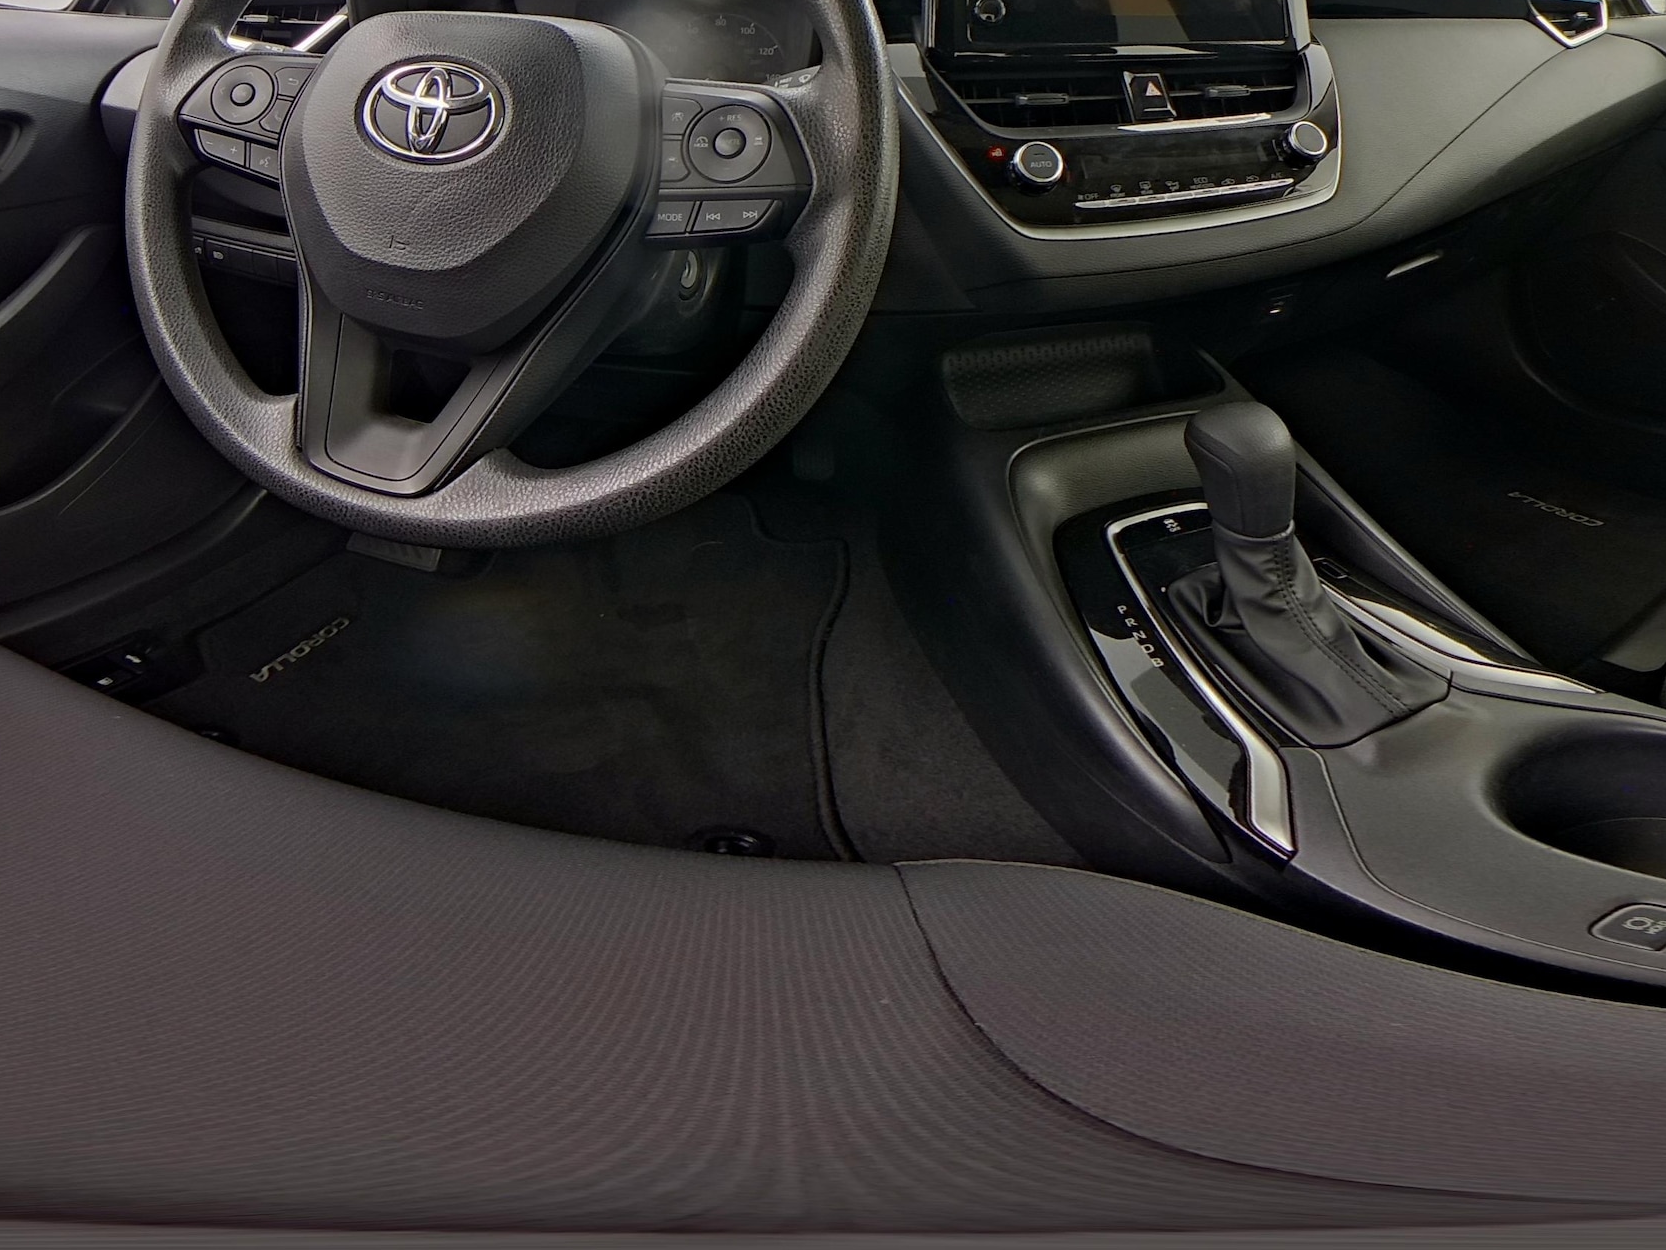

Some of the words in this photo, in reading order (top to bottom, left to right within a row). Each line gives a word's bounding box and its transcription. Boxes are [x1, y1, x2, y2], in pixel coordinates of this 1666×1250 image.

[741, 27, 755, 35] 100
[759, 48, 774, 56] 120
[1030, 160, 1053, 168] AUTO
[1193, 176, 1208, 184] ECO
[657, 213, 683, 222] MODE
[1507, 491, 1605, 527] COROLLA
[1117, 605, 1127, 614] P
[1124, 617, 1138, 627] R
[1132, 630, 1147, 640] N
[1141, 643, 1155, 653] D
[1151, 657, 1164, 668] B
[249, 617, 350, 683] COROLLA
